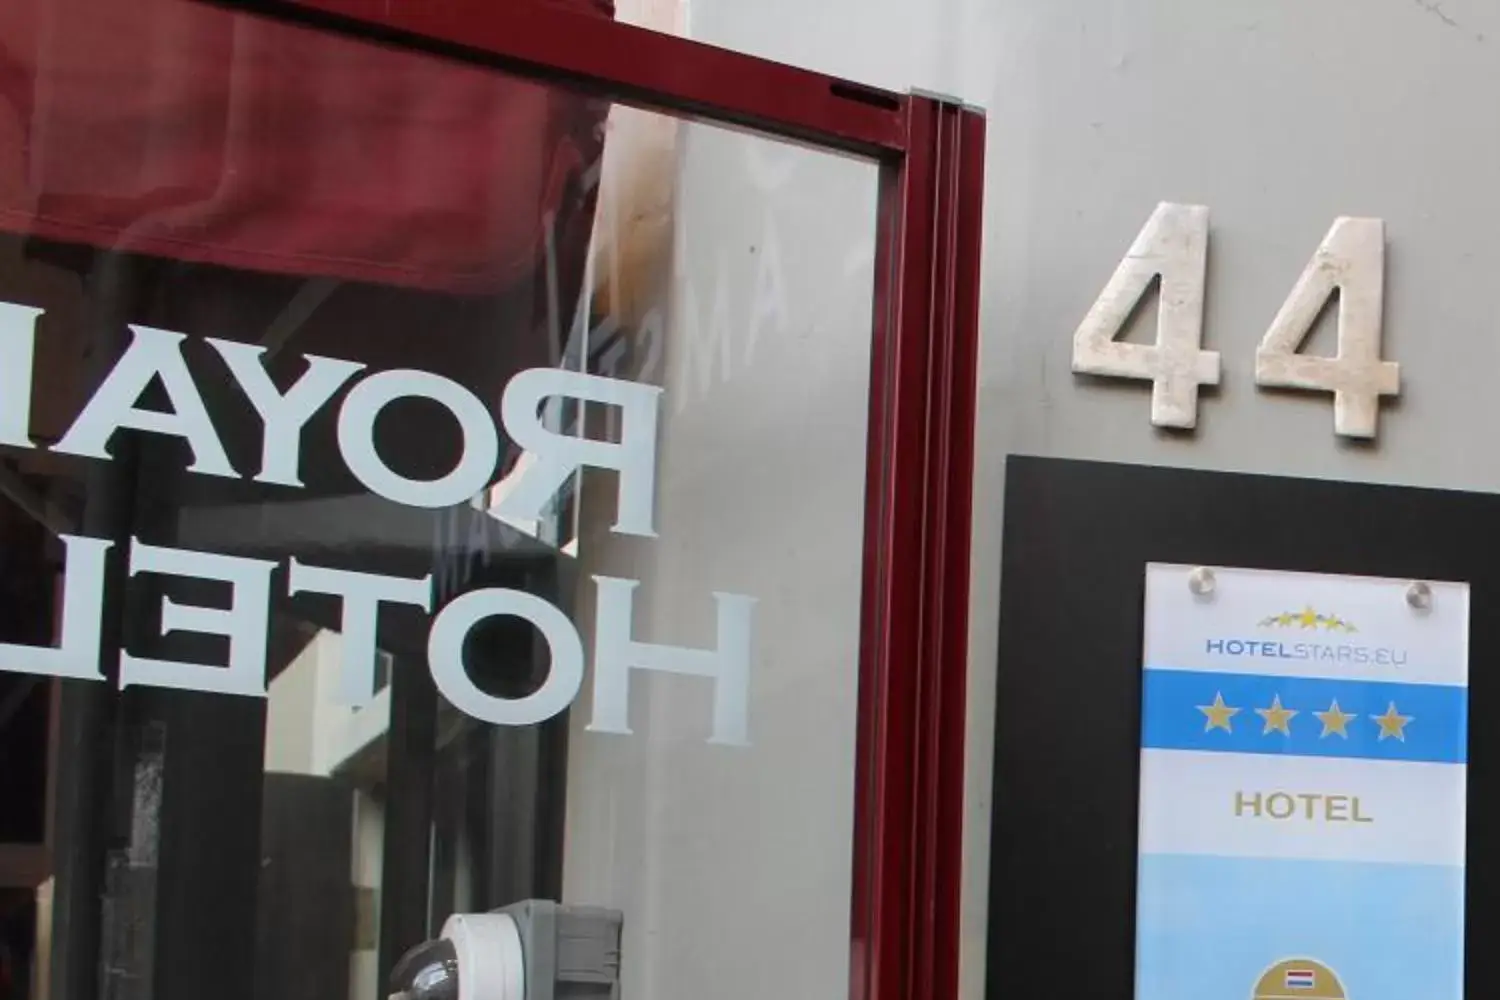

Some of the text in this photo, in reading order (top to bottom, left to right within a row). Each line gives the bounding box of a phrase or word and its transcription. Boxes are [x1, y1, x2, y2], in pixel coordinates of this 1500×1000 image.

[1072, 201, 1401, 438] 44
[1205, 639, 1408, 666] HOTELSTARS.EU
[1234, 791, 1374, 823] HOTEL
